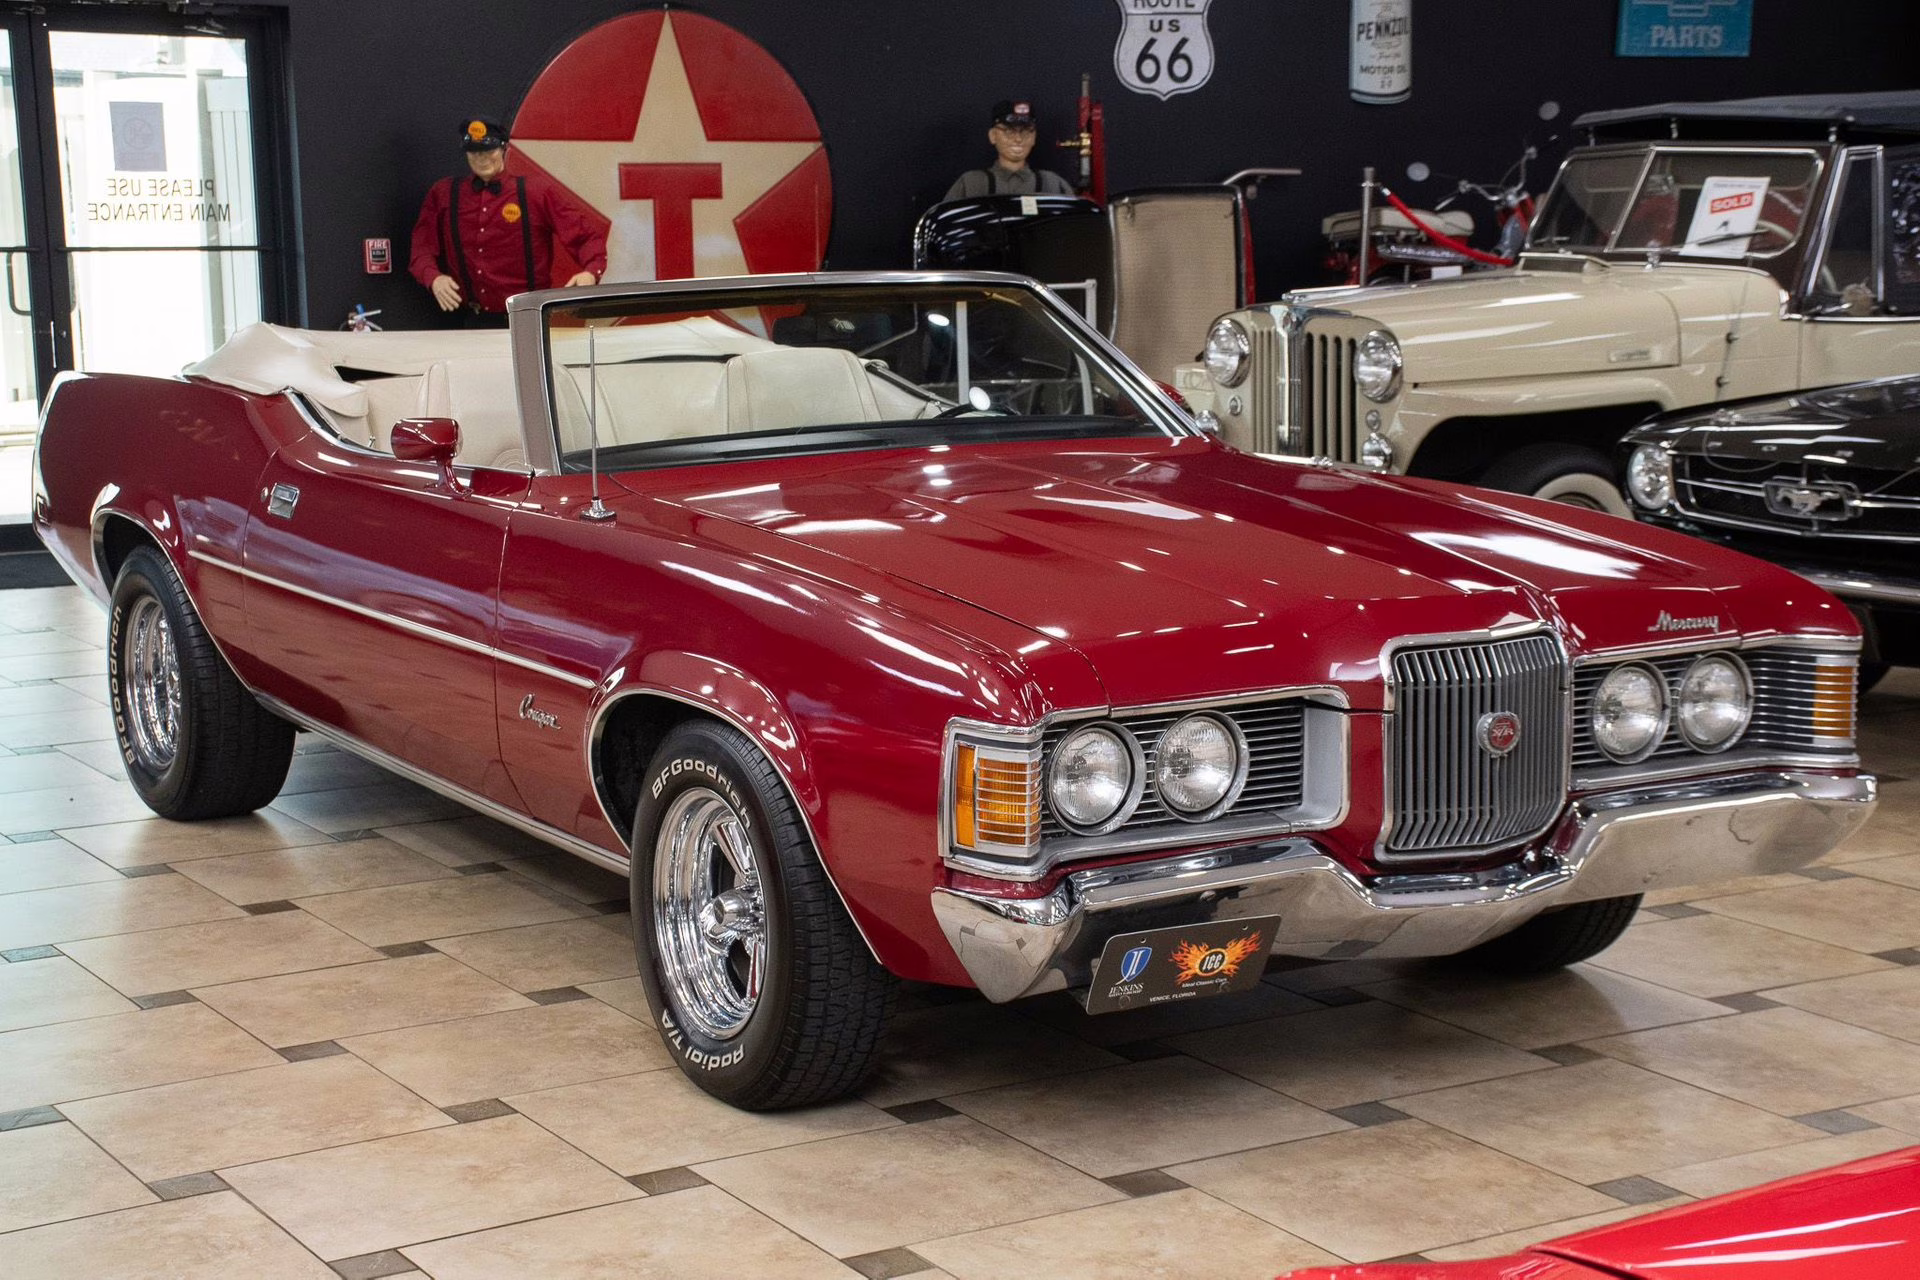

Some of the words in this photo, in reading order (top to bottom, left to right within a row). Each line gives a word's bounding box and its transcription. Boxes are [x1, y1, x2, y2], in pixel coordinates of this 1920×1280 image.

[1149, 19, 1181, 33] US
[1650, 25, 1723, 48] PARTS
[1136, 37, 1193, 84] 66
[1360, 65, 1394, 75] MOTOR
[1711, 193, 1753, 212] SOLD
[618, 163, 723, 281] T
[368, 240, 388, 249] FIRE
[1647, 609, 1719, 633] Mercury
[109, 606, 137, 765] BFGoodrich
[519, 693, 561, 730] Cougar
[652, 759, 751, 830] BFGoodrich
[1202, 953, 1223, 971] ICC
[1110, 983, 1145, 993] JENKINS
[1172, 991, 1197, 999] FLORIDA
[662, 1009, 684, 1051] T/A
[685, 1043, 744, 1071] Radial
